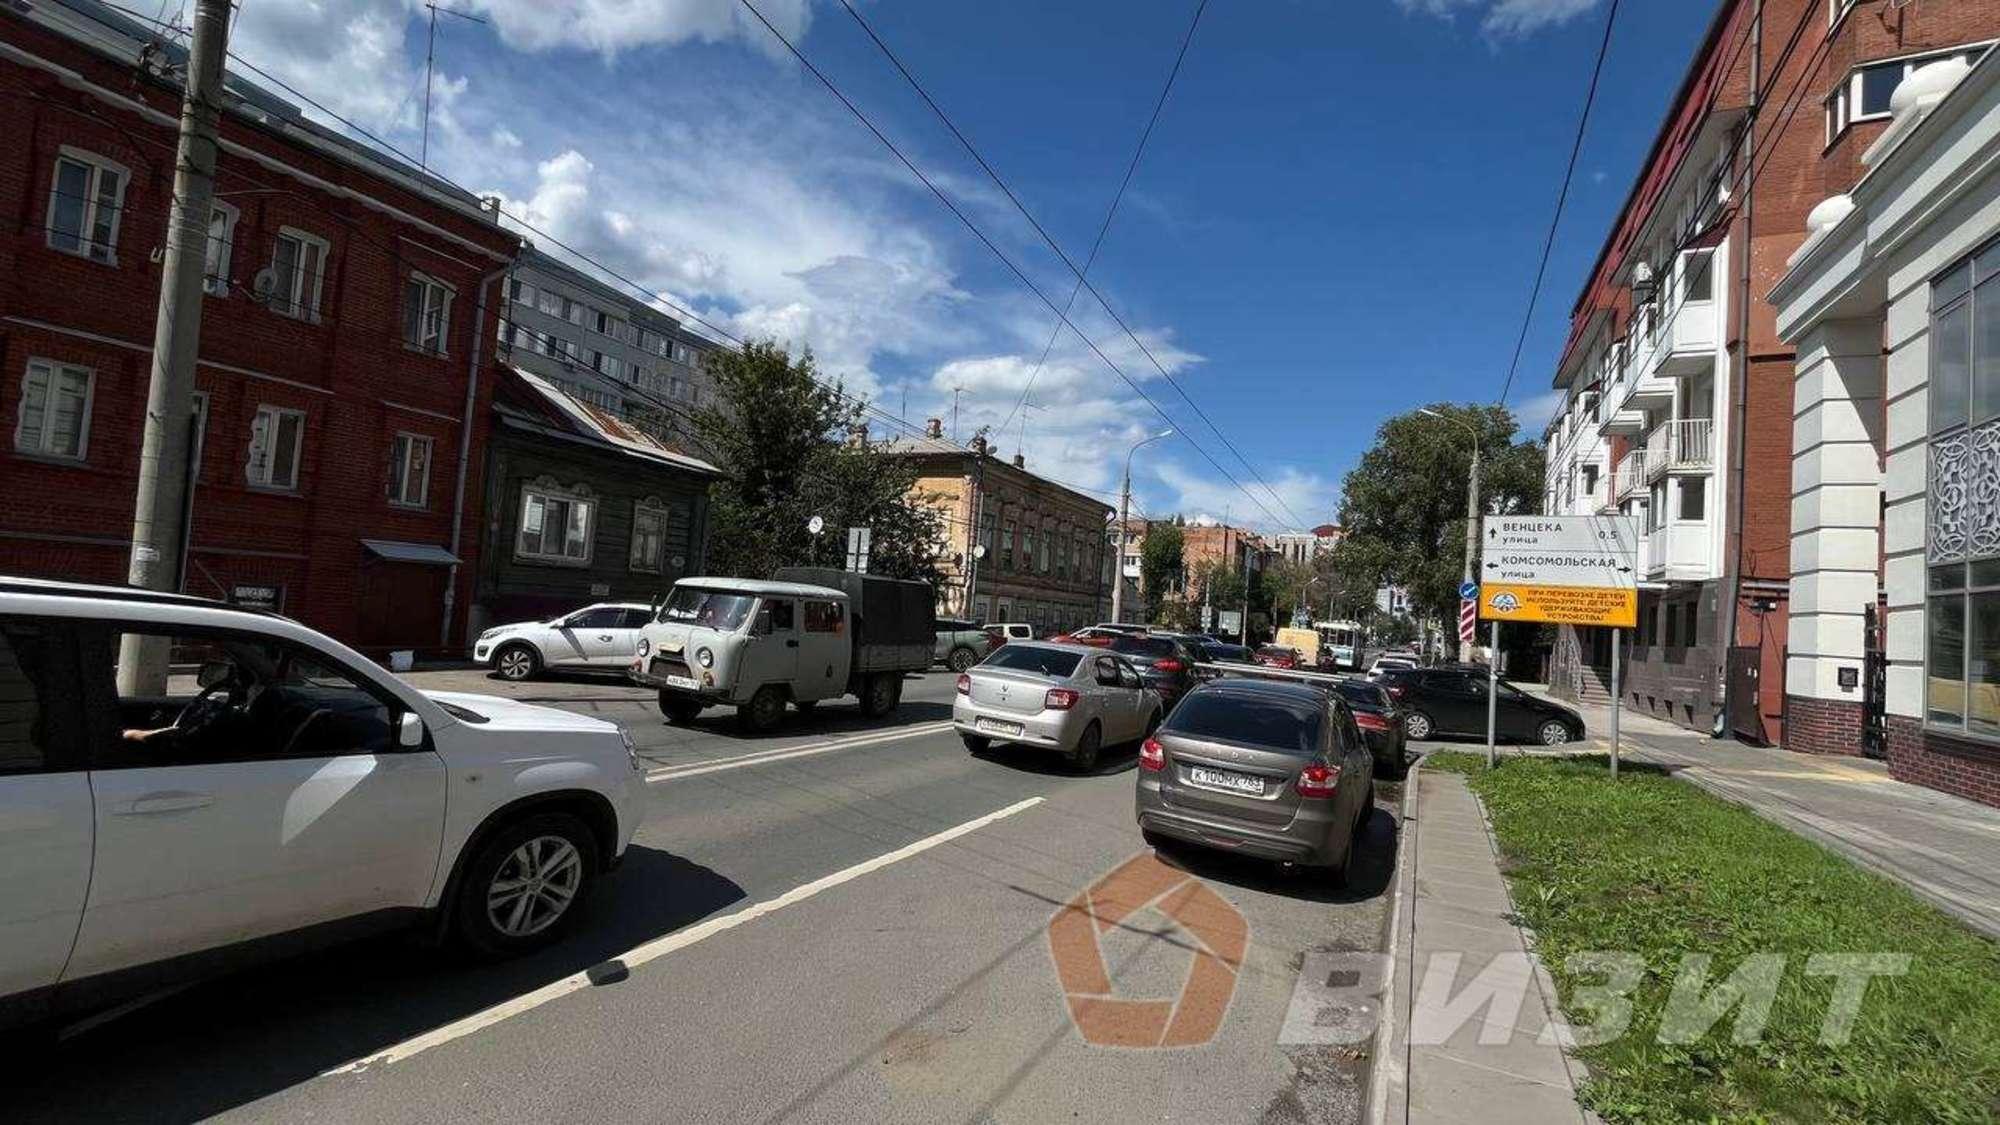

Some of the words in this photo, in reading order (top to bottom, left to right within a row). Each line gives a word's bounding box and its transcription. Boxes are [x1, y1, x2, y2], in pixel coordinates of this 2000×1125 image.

[1502, 522, 1562, 532] ВЕНЦЕКА
[1502, 536, 1538, 545] улица
[1501, 555, 1616, 567] КОМСОМОЛЬСКАЯ
[1501, 571, 1535, 579] улица
